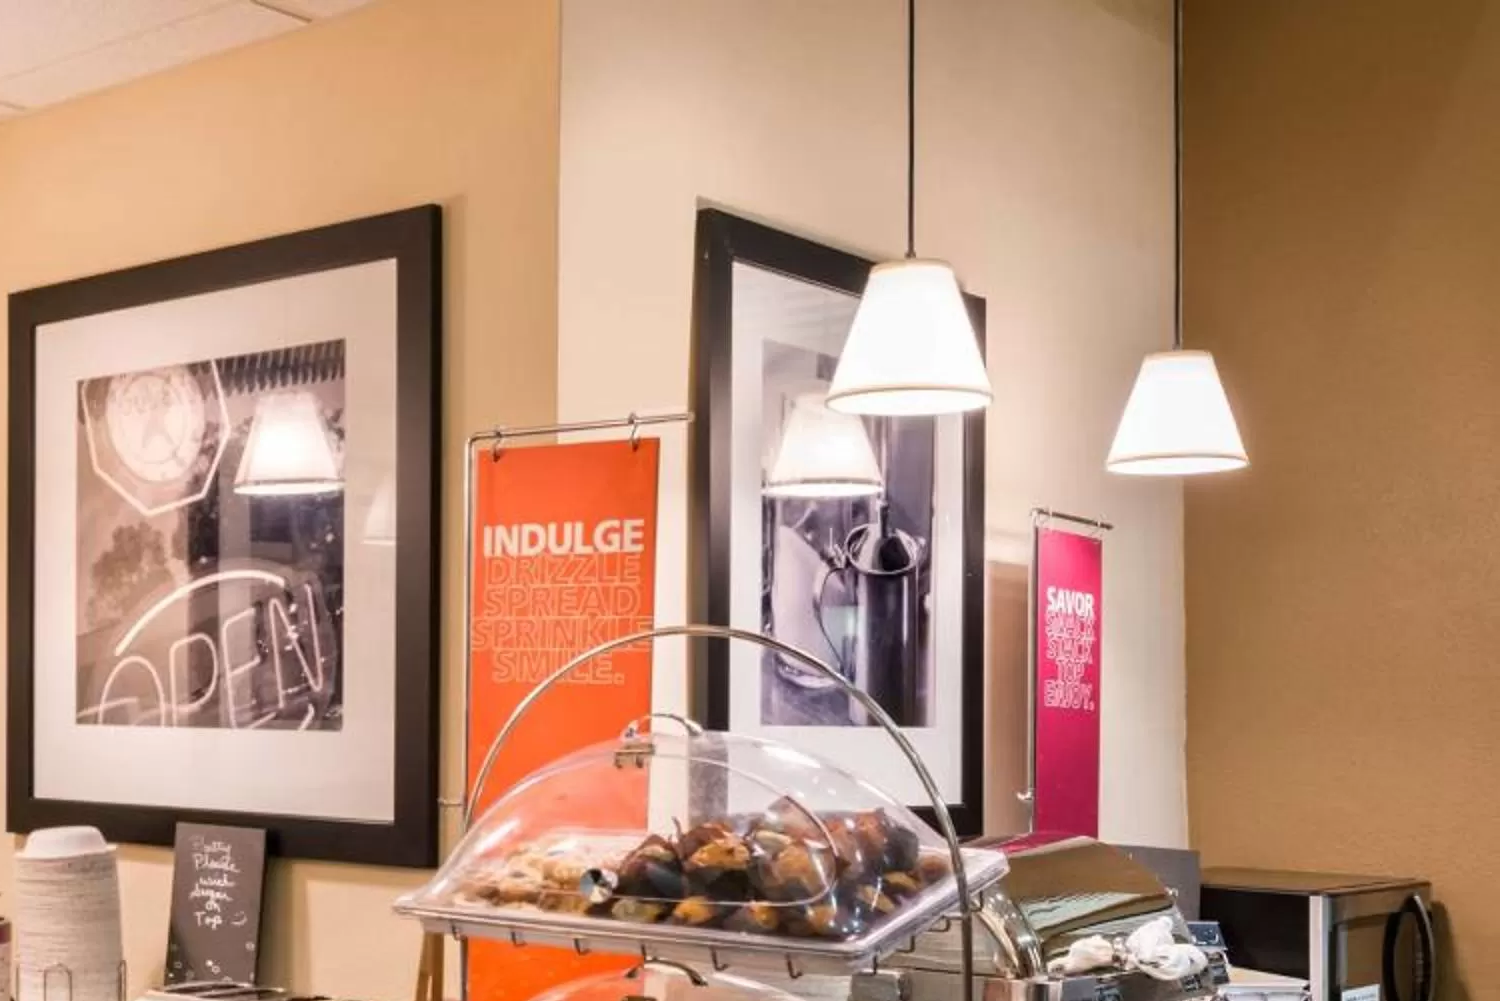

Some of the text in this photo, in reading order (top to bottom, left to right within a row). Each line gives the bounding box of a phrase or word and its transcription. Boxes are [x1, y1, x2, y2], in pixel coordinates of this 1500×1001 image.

[483, 519, 645, 557] INDULGE
[485, 553, 642, 587] DRIZZLE
[484, 584, 641, 619] SPREAD
[1046, 586, 1095, 618] SAVOR
[471, 616, 654, 652] SPRINKLE
